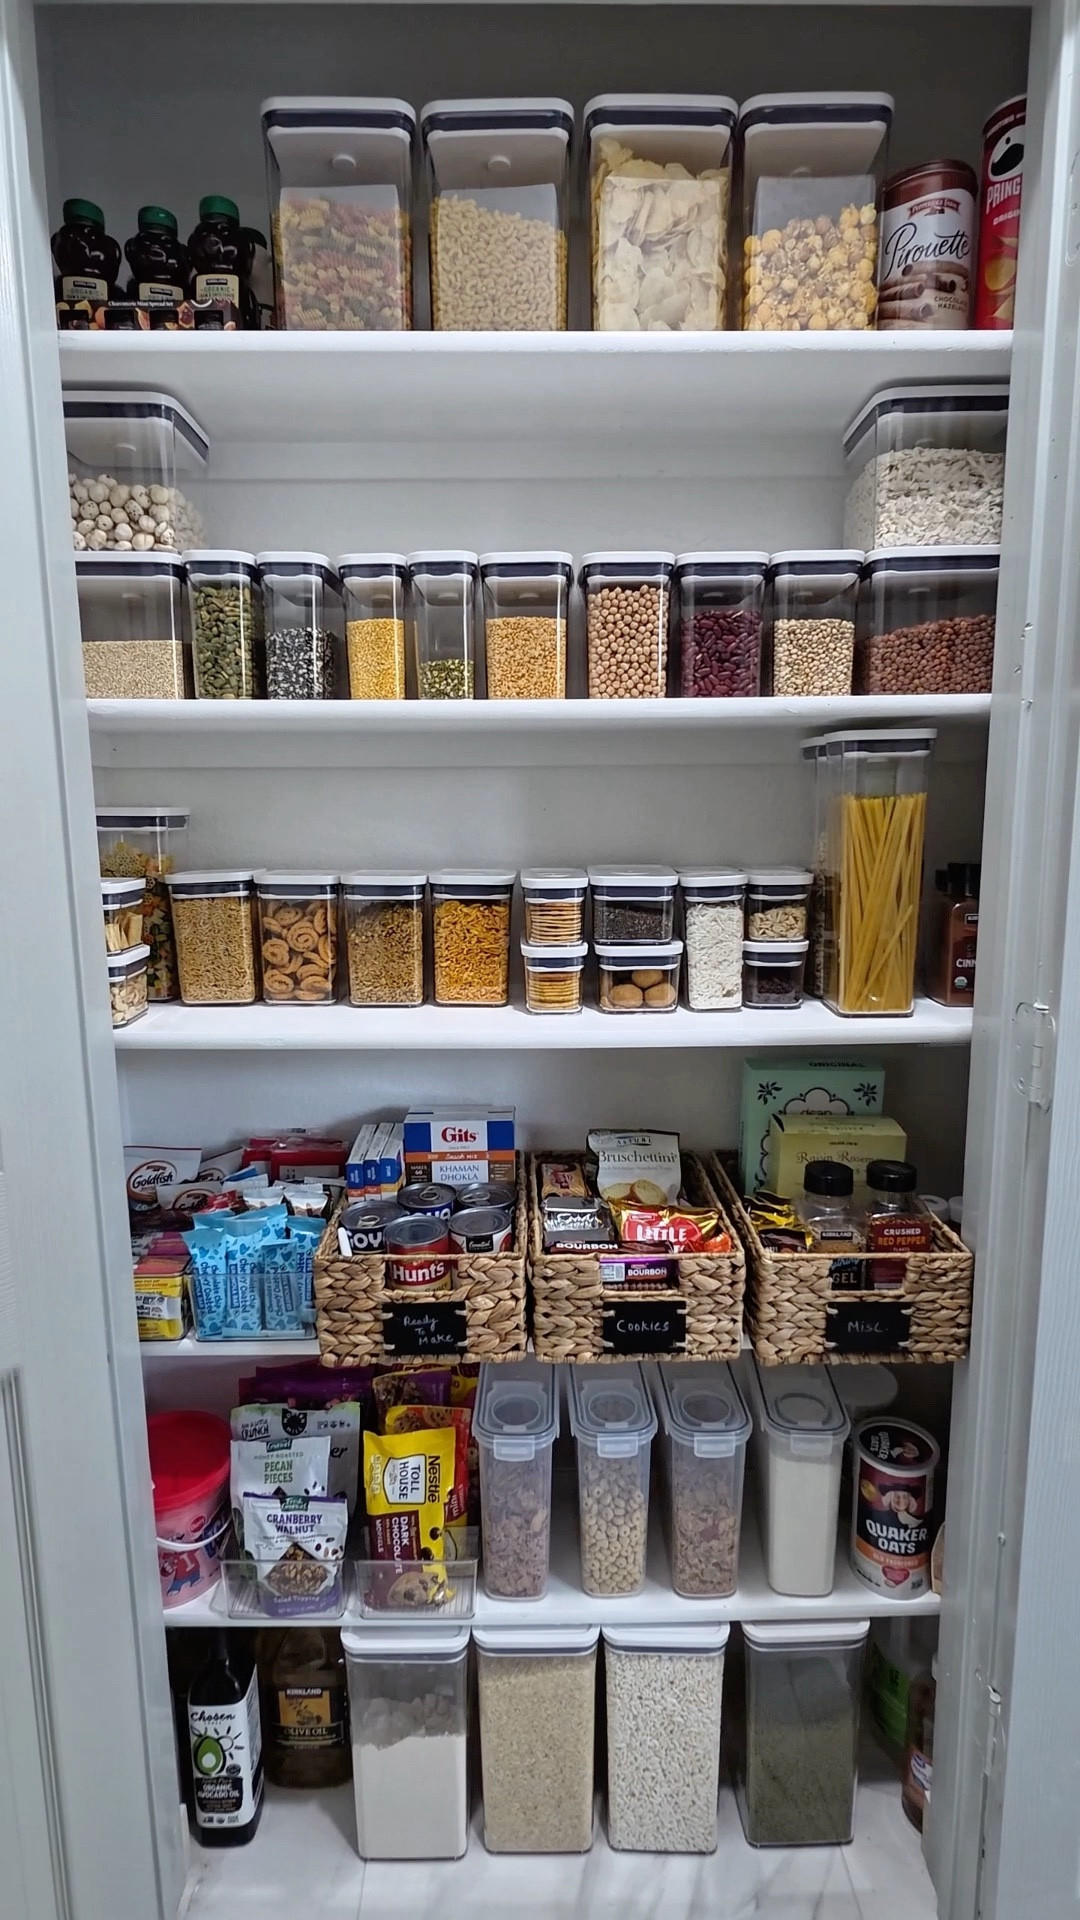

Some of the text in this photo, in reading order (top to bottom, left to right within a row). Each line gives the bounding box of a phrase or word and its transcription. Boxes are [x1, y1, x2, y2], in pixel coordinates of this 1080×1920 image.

[884, 222, 970, 281] Pirouette
[441, 1126, 478, 1143] Gits
[599, 1150, 675, 1163] Bruschettini
[837, 1150, 875, 1163] Rosem
[440, 1164, 479, 1173] KHAMAN
[132, 1171, 174, 1189] Goldfish
[440, 1173, 479, 1182] DHOKLA
[637, 1225, 687, 1242] LITTLE
[884, 1228, 921, 1236] CRUSHED
[878, 1236, 926, 1246] RED PEPPER
[393, 1260, 445, 1282] Hunt's
[628, 1267, 667, 1277] BOURBON
[833, 1272, 857, 1284] GEL
[403, 1314, 439, 1332] Ready
[616, 1319, 670, 1333] Cookies
[848, 1320, 889, 1333] Misc.
[415, 1328, 426, 1336] To
[419, 1334, 454, 1346] Make
[264, 1460, 293, 1472] PECAN
[264, 1472, 293, 1484] PIECES
[398, 1461, 409, 1500] HOUSE
[410, 1465, 421, 1494] TOLL
[266, 1513, 323, 1524] CRANBERRY
[275, 1524, 315, 1535] WALNUT
[400, 1516, 410, 1546] DARK
[866, 1519, 927, 1541] QUAKER
[878, 1537, 916, 1554] OATS
[190, 1710, 236, 1722] Chosen
[284, 1727, 328, 1736] OLIVE OIL
